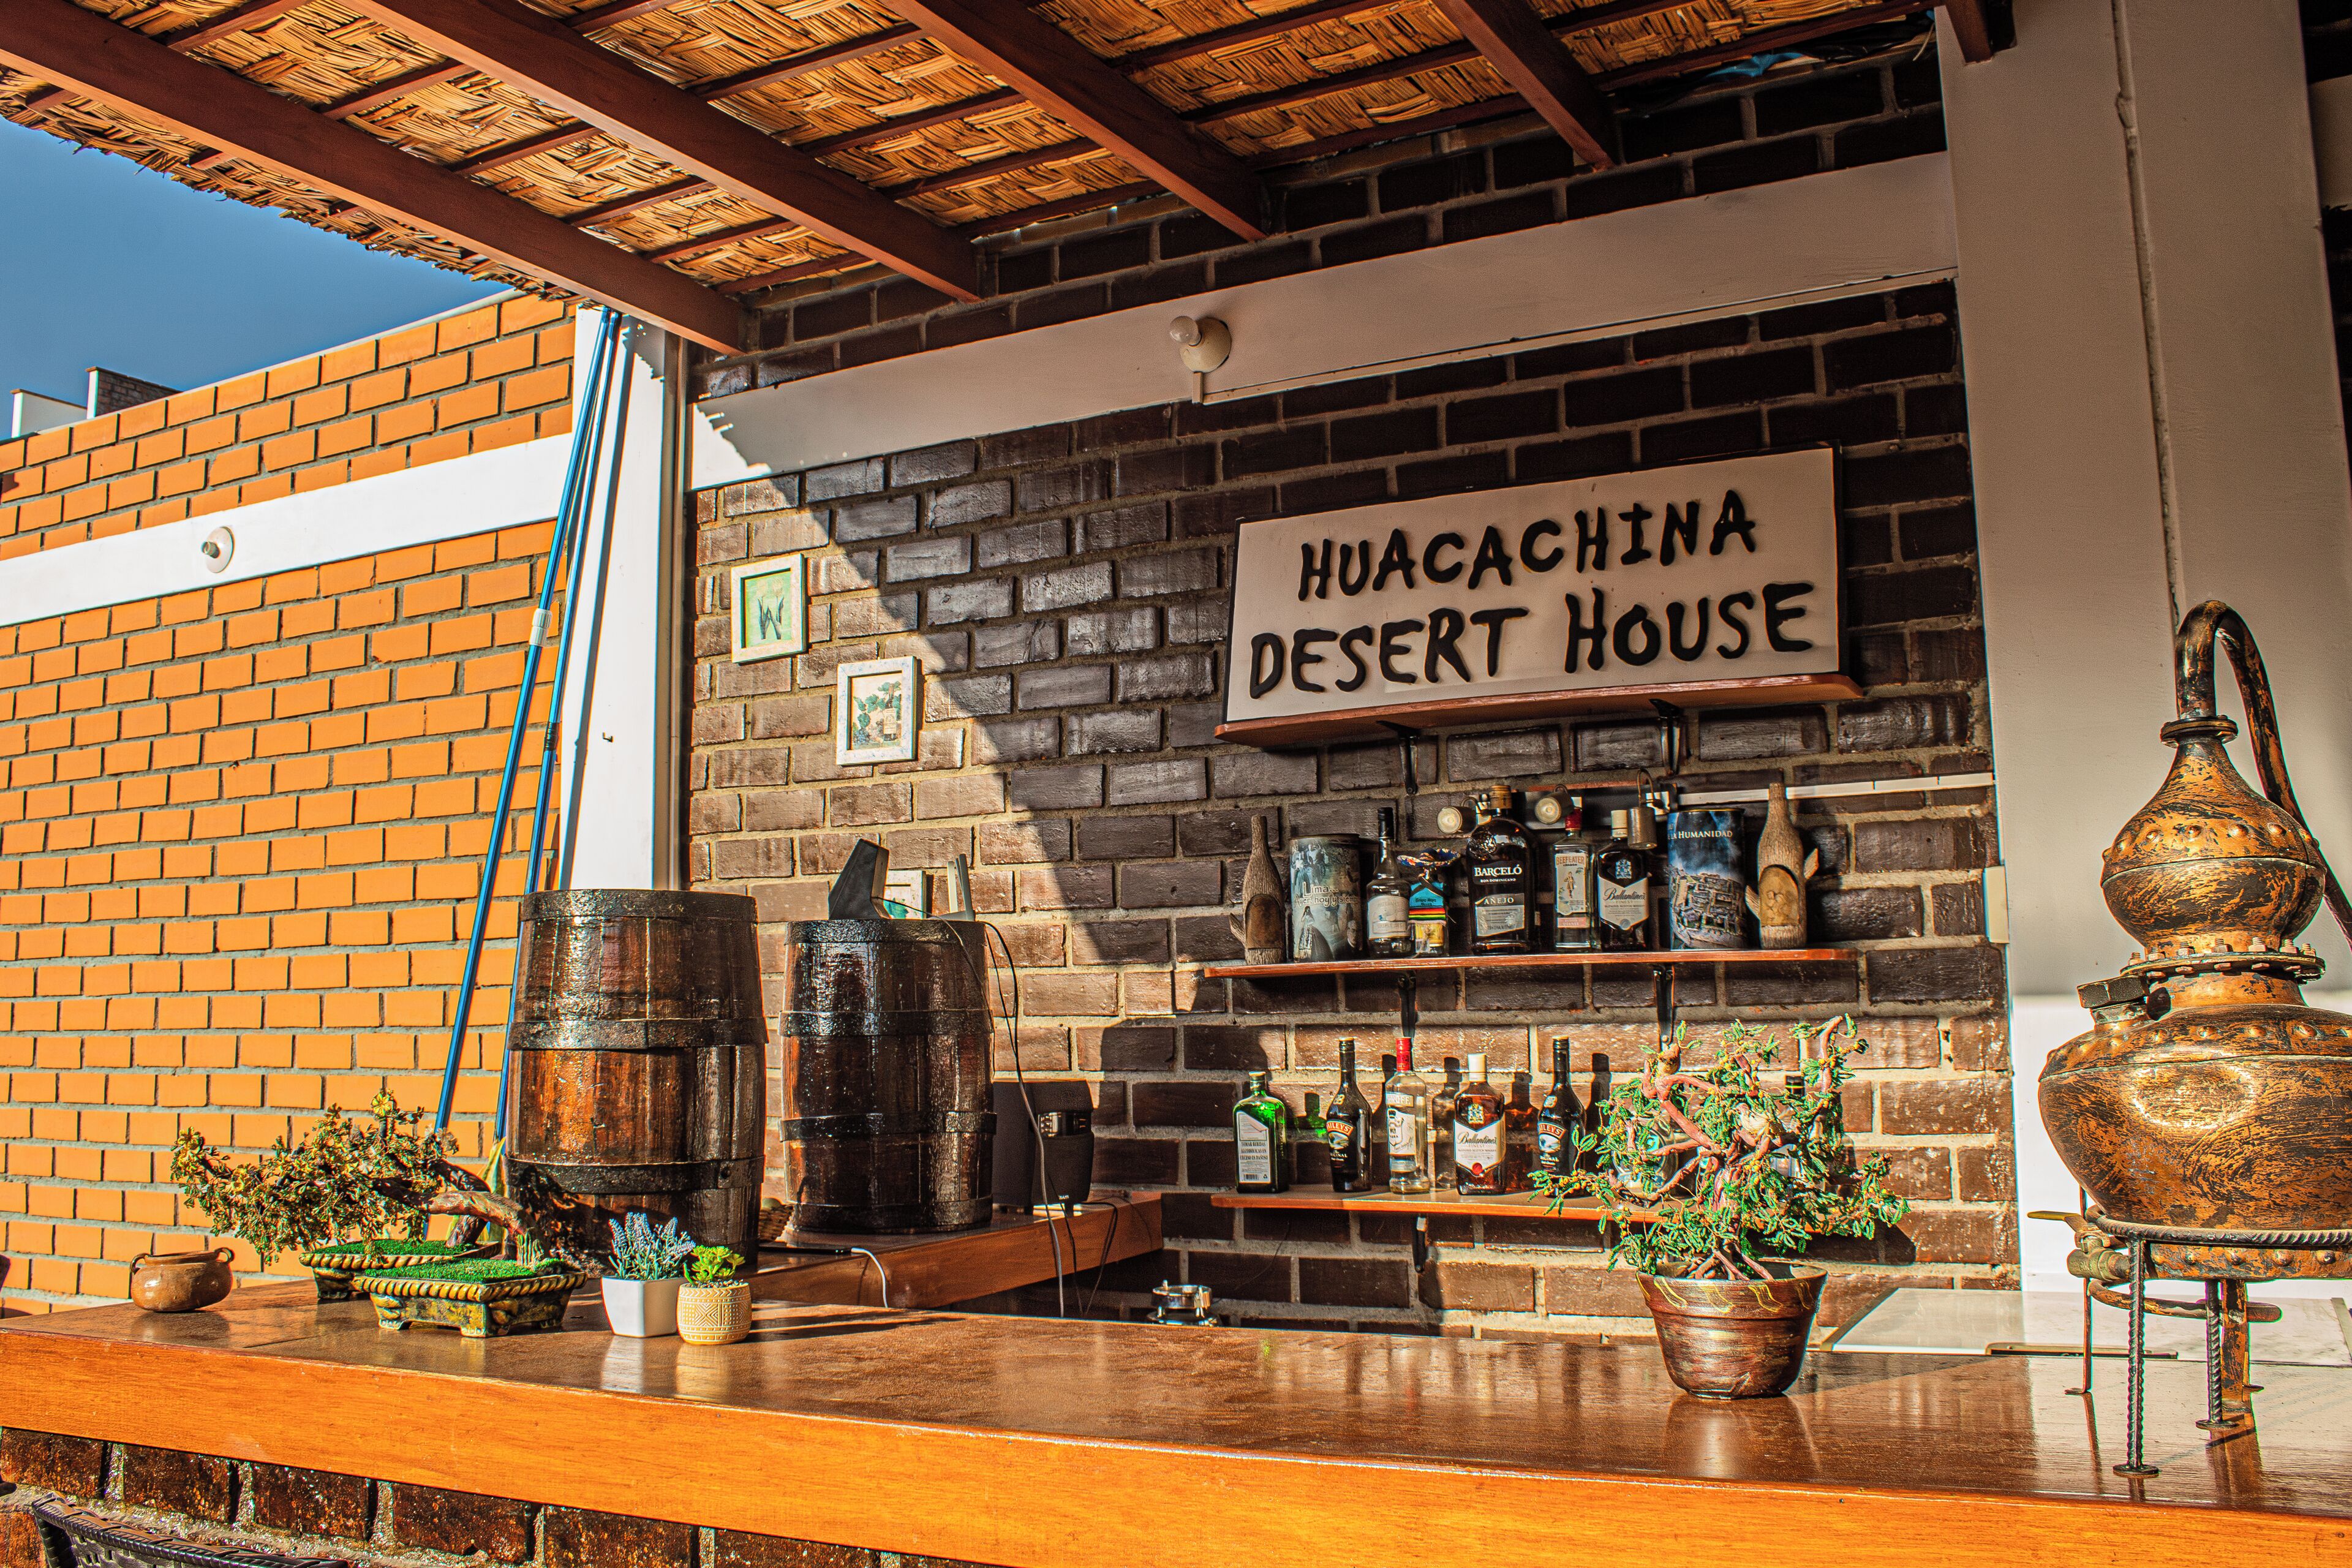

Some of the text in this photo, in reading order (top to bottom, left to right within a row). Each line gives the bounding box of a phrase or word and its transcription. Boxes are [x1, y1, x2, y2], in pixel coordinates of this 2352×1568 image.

[1297, 490, 1755, 602] HUACACHINA
[1249, 582, 1814, 699] DESERT HOUSE
[1678, 831, 1733, 839] HUMANIDAD
[1556, 856, 1585, 865] BEEFEATER
[1474, 864, 1523, 876] BARCELÓ
[1327, 1122, 1351, 1133] AILEYS
[1539, 1124, 1562, 1135] ILEYS
